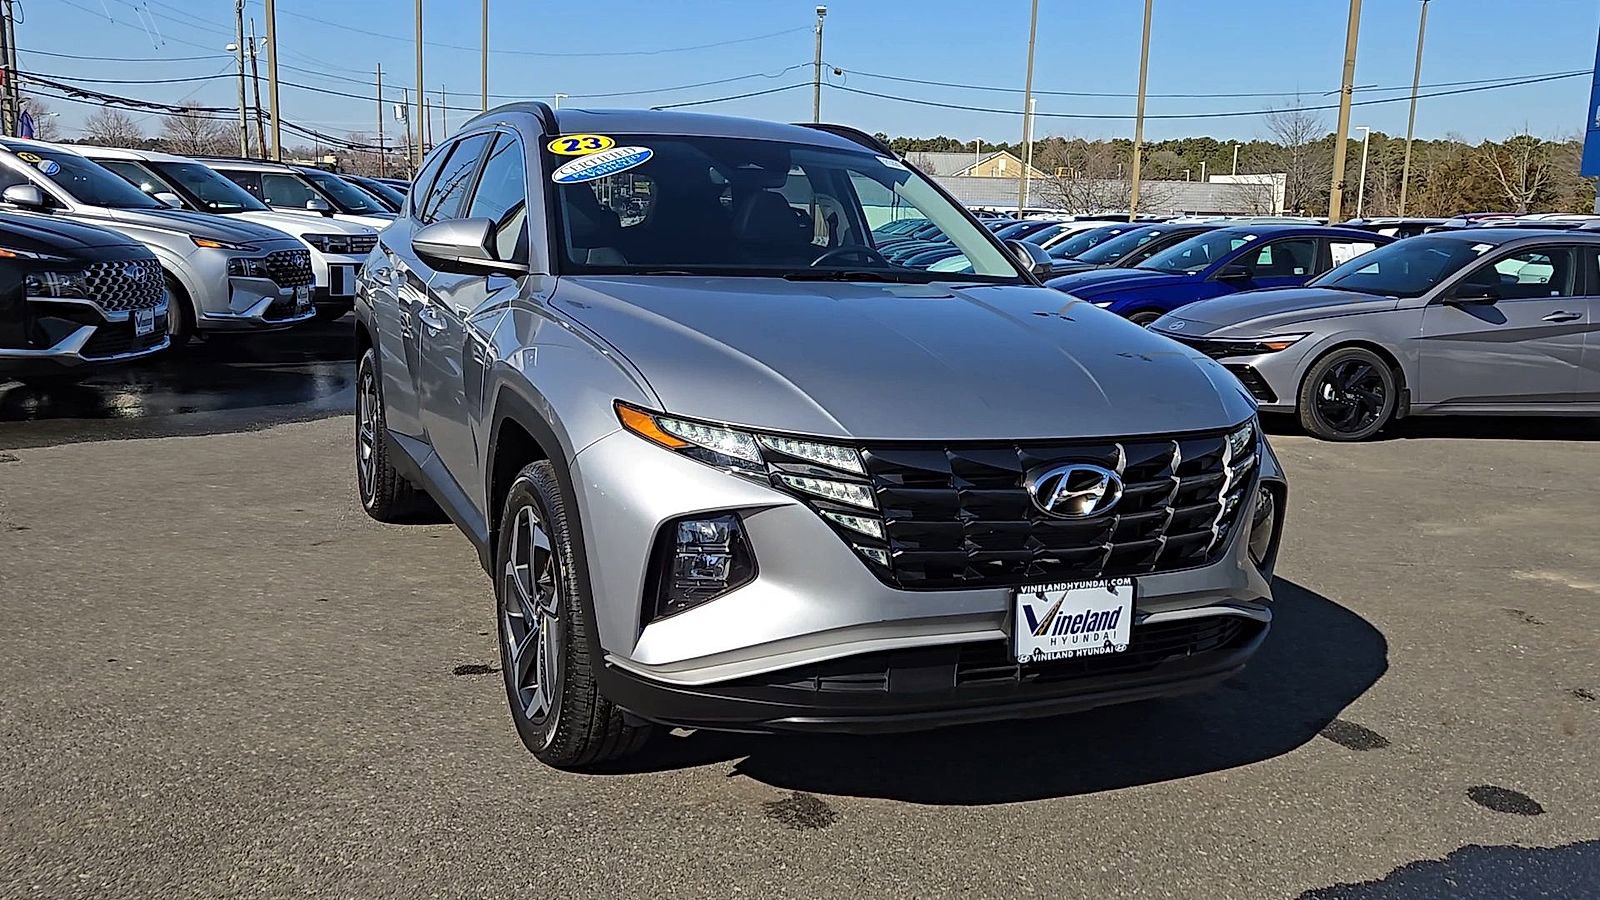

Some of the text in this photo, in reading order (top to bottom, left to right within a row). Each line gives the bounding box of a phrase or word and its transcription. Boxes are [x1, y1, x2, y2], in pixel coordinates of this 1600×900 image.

[562, 137, 602, 152] 23
[560, 147, 636, 174] CERTIFIED
[1020, 577, 1131, 594] VINELANDHYUNDAI.COM
[1022, 590, 1123, 637] Vineland
[1050, 631, 1117, 647] HYUNDAI
[1032, 645, 1114, 662] VINELAND HYUNDAI
